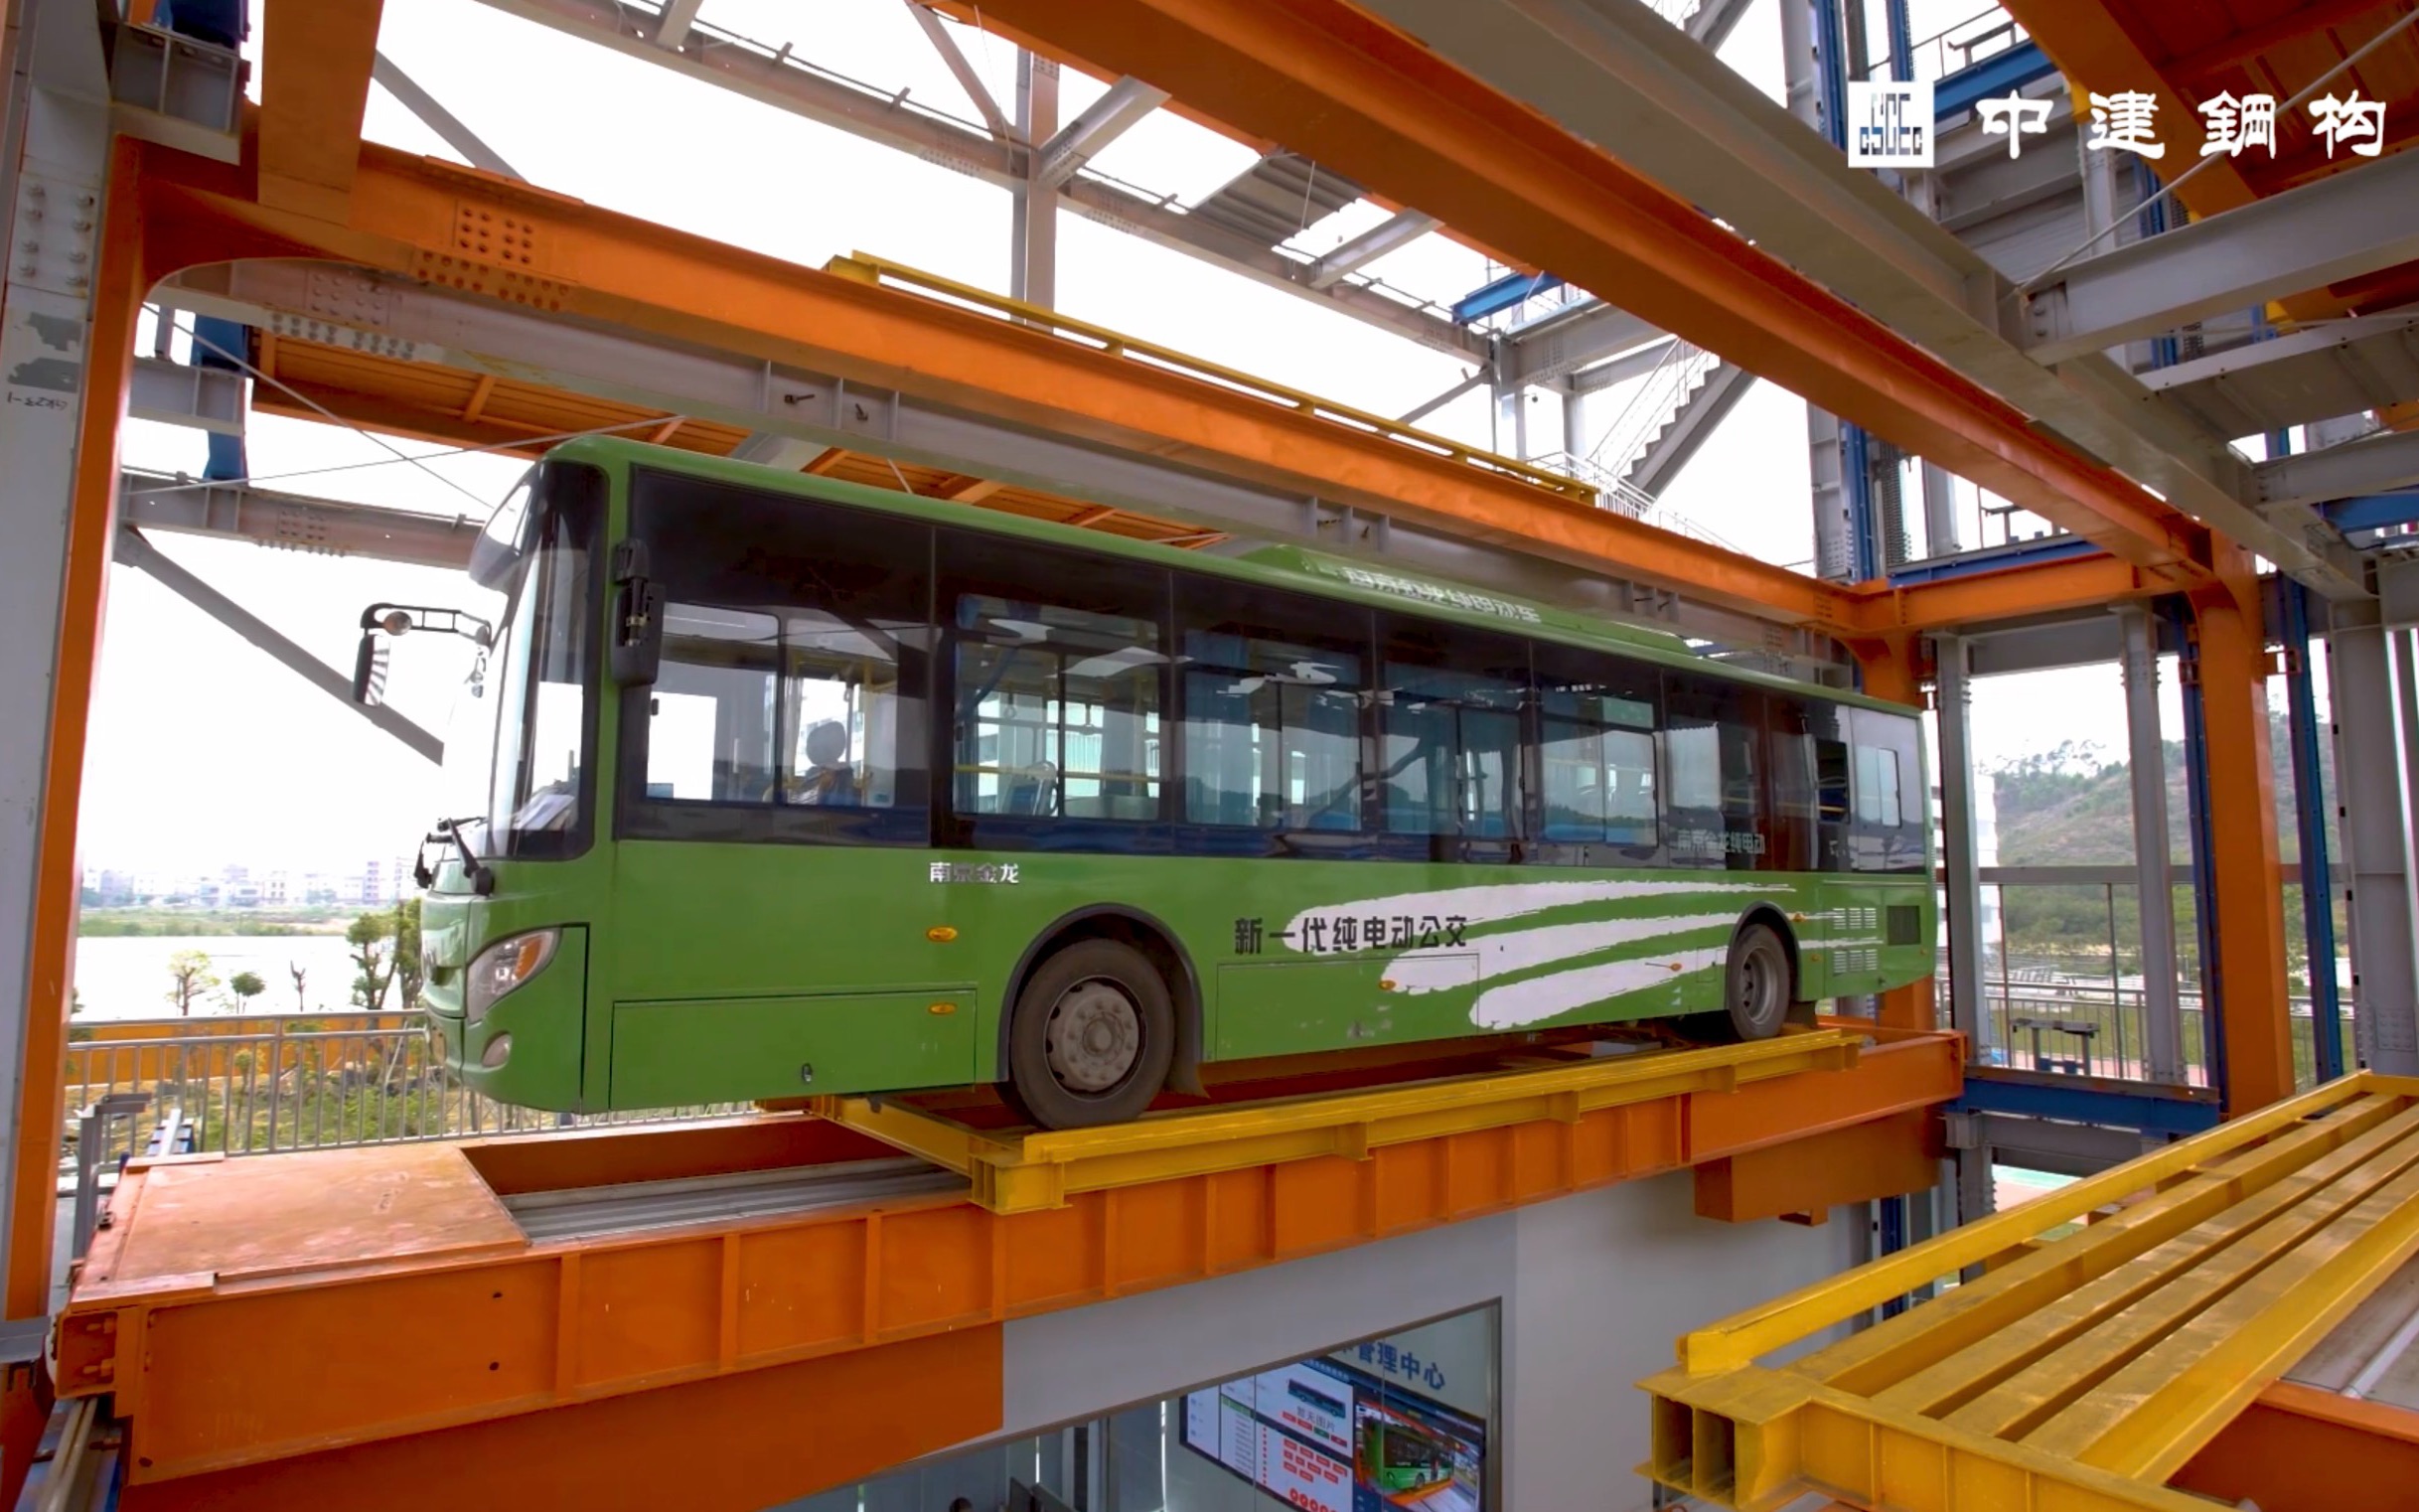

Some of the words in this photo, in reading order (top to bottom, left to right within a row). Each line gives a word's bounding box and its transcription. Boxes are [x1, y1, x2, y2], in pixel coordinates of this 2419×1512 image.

[929, 861, 1020, 884] 南京金龙
[1234, 915, 1467, 955] 新一代纯电动公交
[1343, 1341, 1446, 1391] 管理中心
